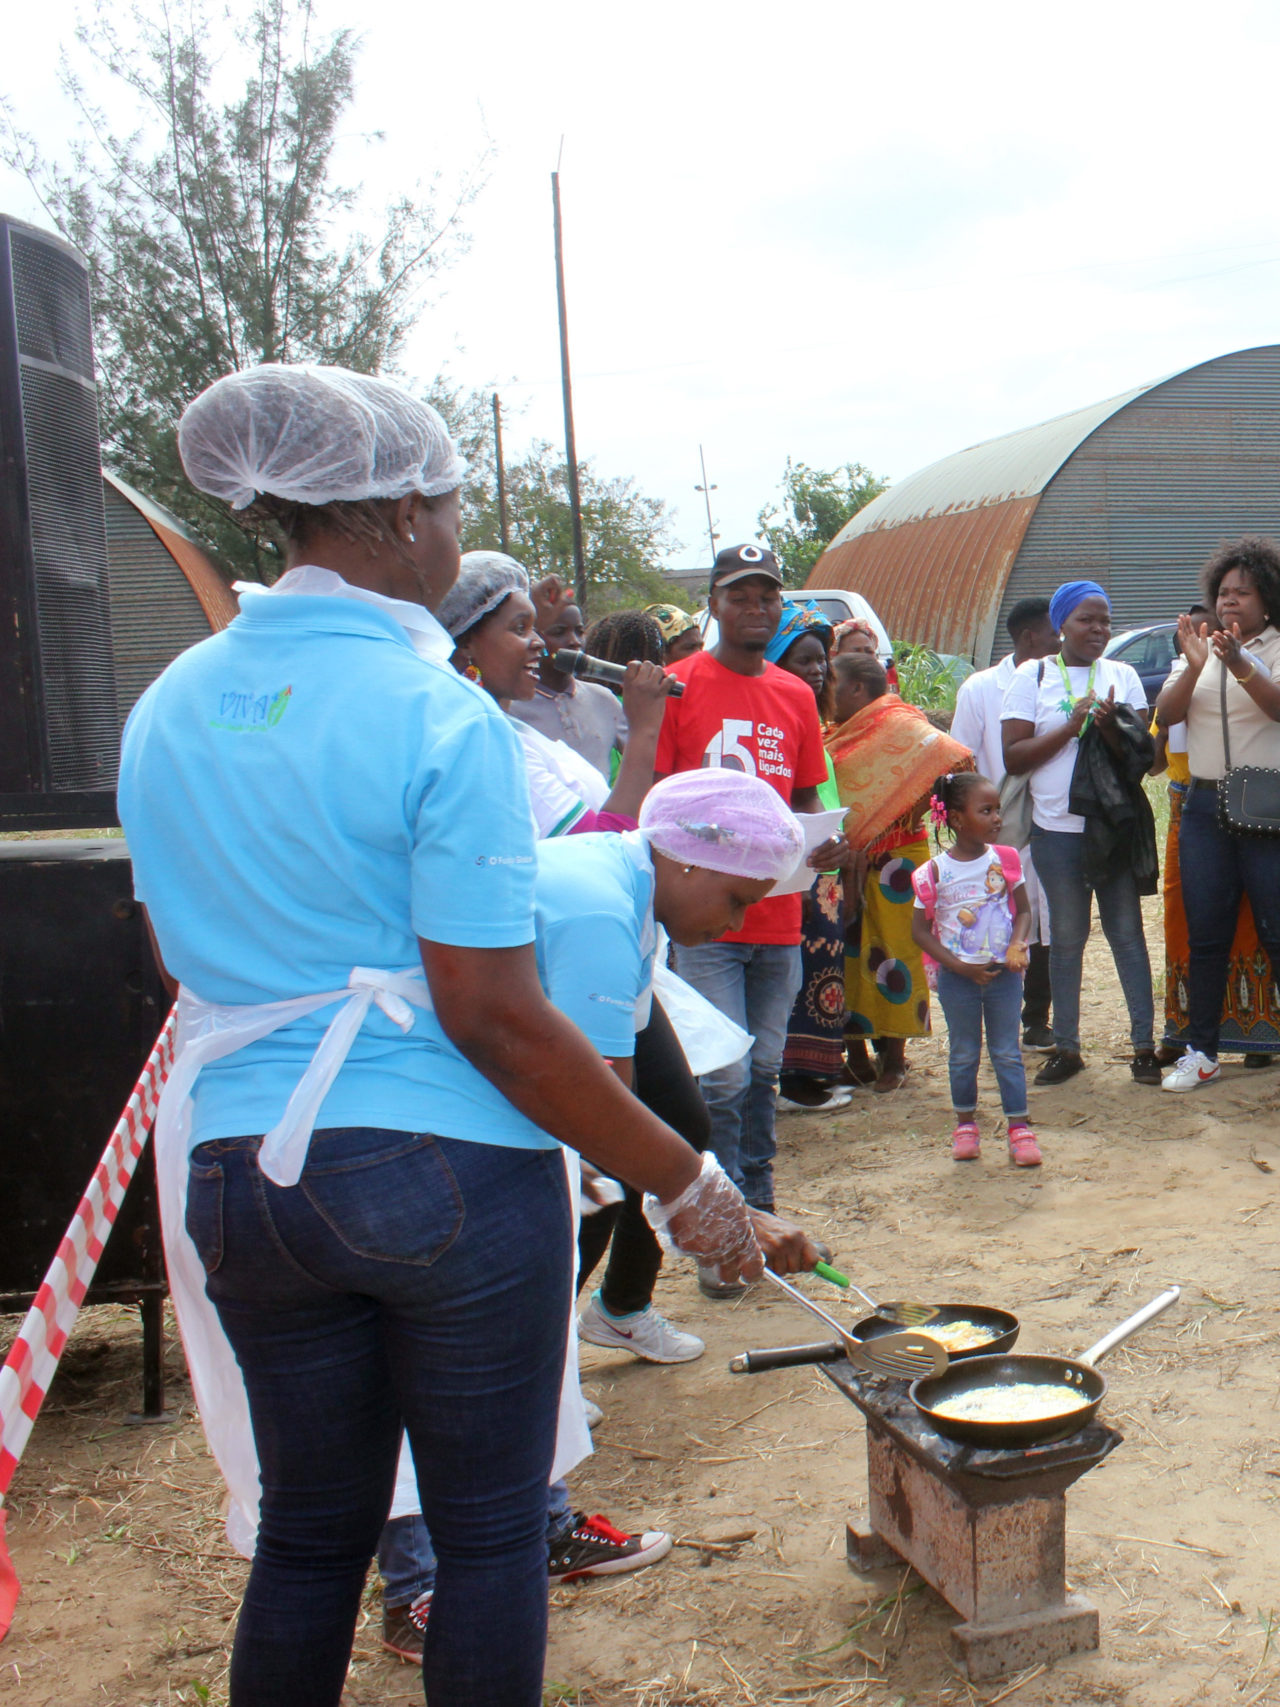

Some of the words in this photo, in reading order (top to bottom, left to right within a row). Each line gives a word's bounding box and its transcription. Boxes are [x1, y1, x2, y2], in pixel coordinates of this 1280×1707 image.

[757, 723, 784, 739] Cada
[757, 737, 778, 748] vez
[758, 748, 784, 762] mais
[759, 759, 792, 778] ligados
